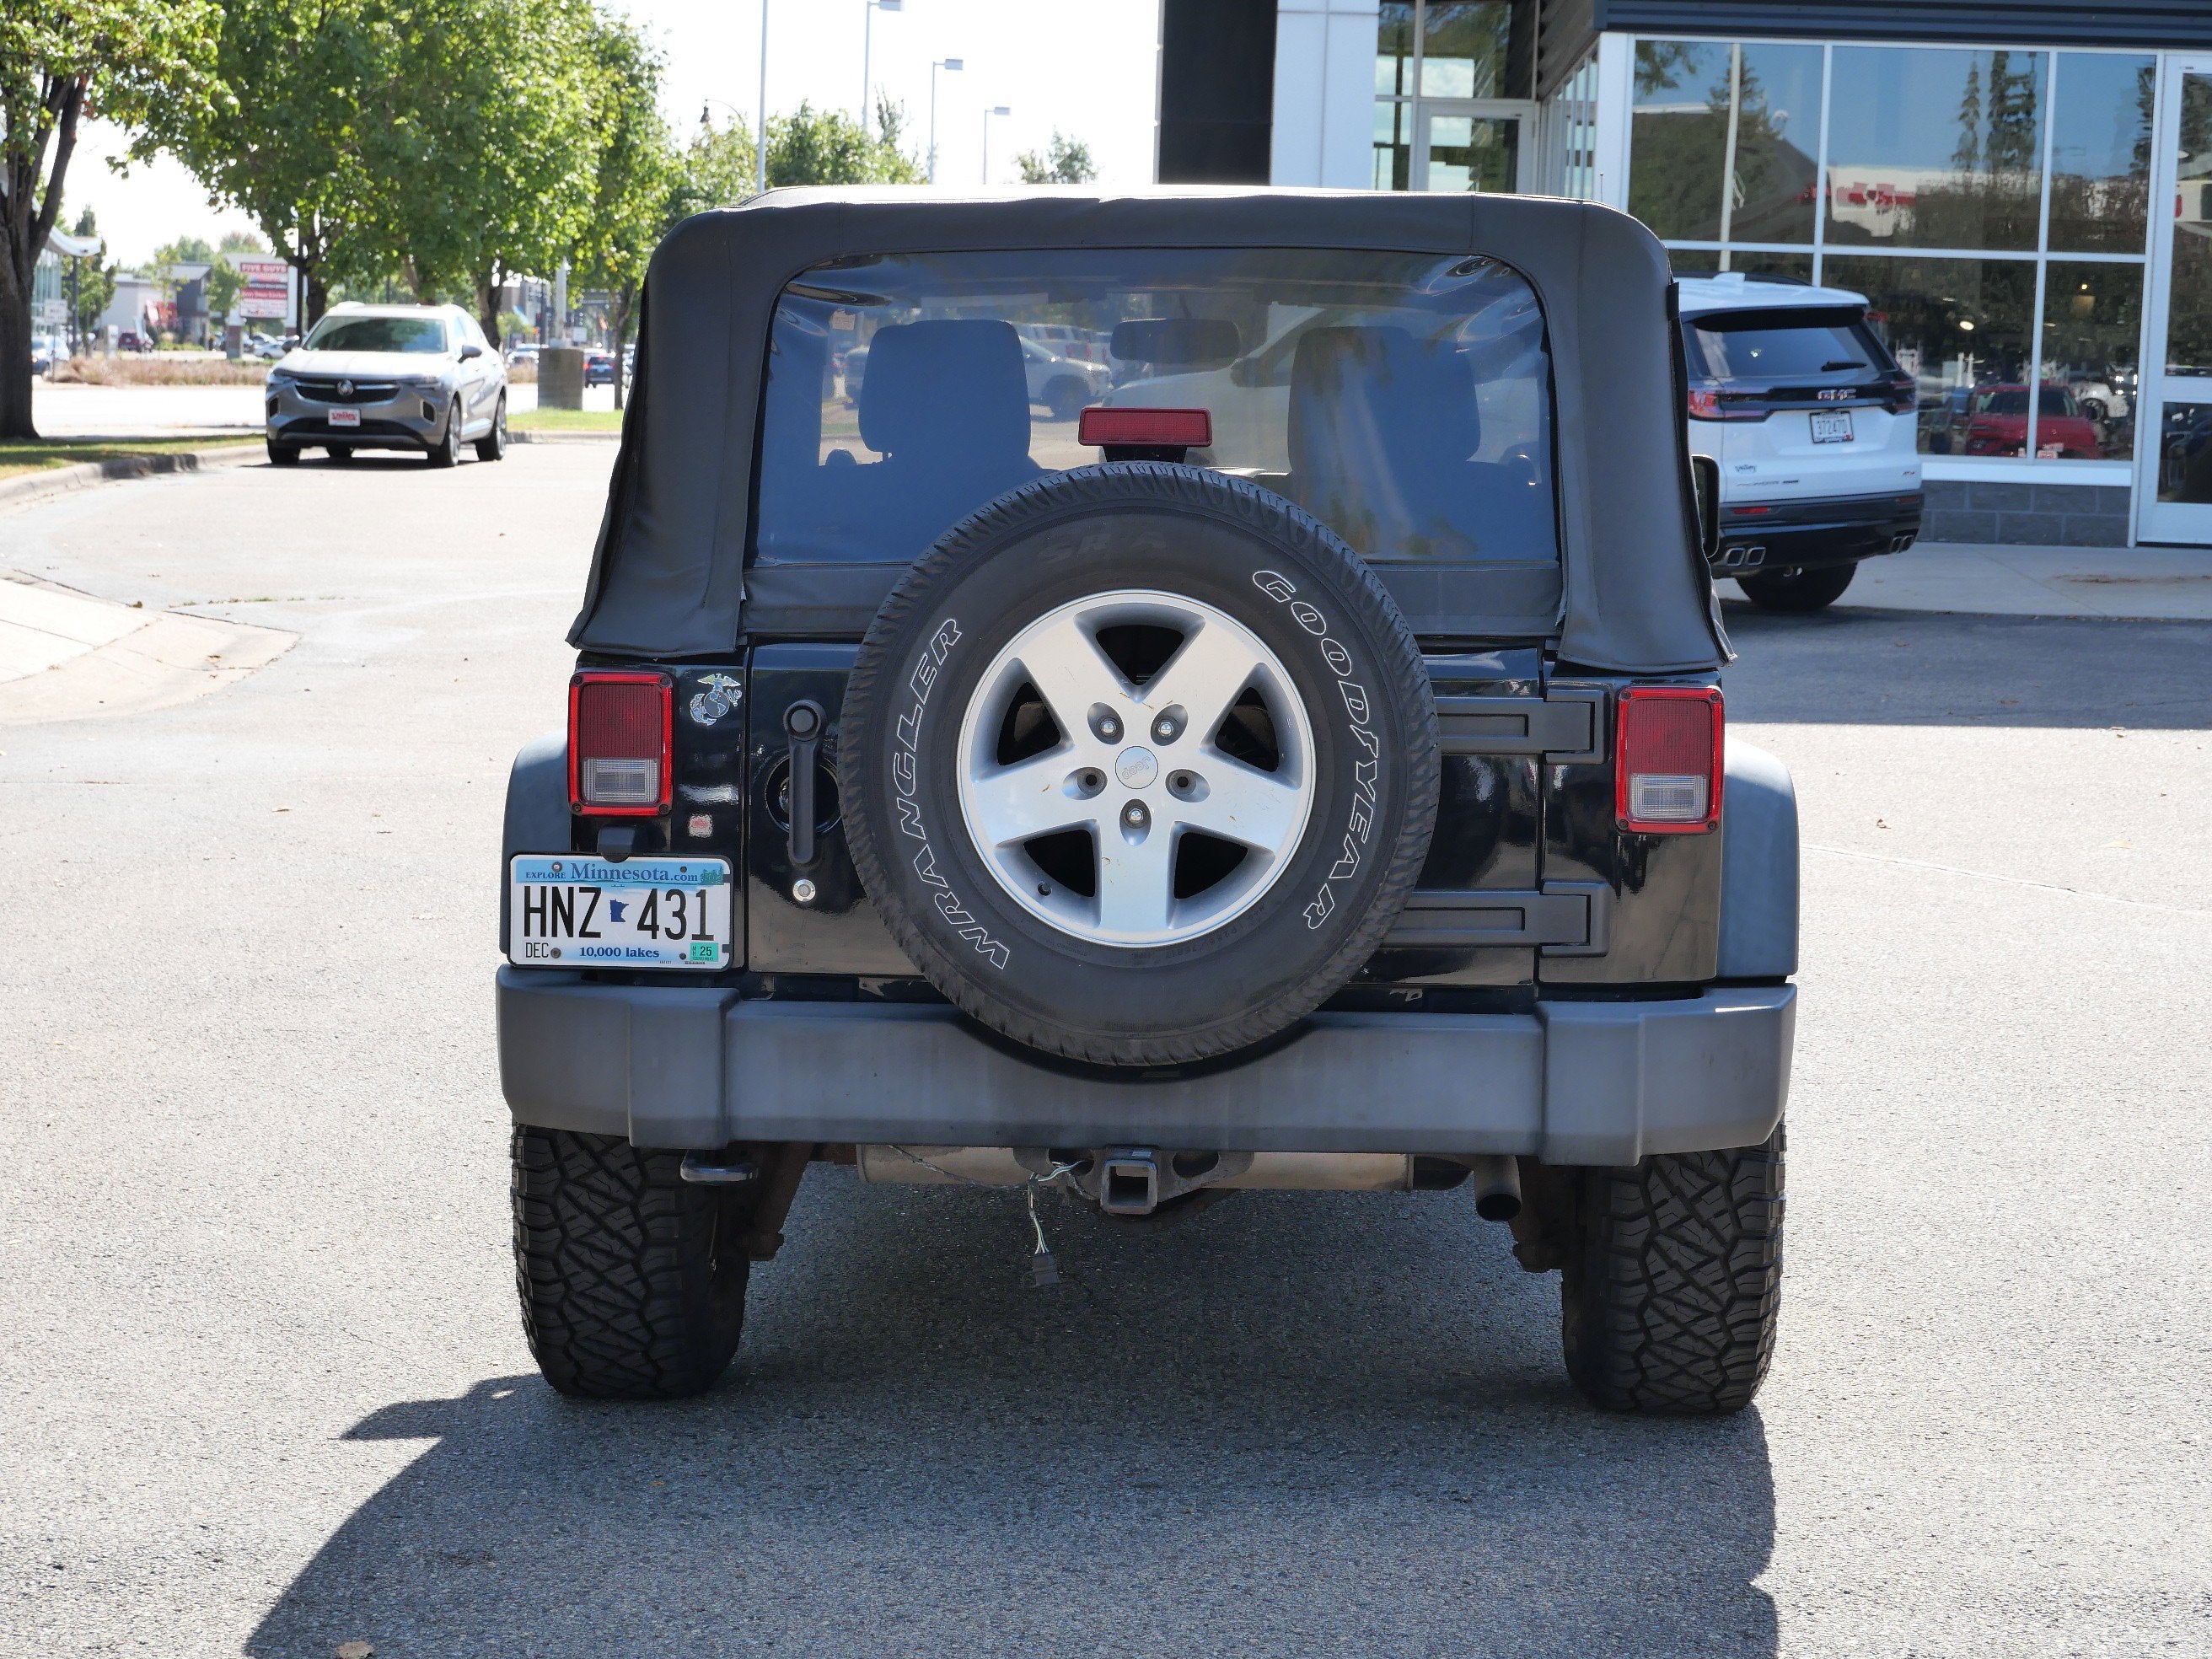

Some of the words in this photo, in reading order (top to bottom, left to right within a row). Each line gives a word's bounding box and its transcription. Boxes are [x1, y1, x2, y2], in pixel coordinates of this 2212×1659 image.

[1817, 389, 1856, 400] GMC
[1253, 571, 1378, 929] GOODYEAR
[893, 619, 1010, 969] WRANGLER
[571, 862, 698, 883] Minnesota.com
[523, 885, 602, 938] HNZ
[636, 888, 714, 941] 431
[525, 942, 549, 958] DEC
[579, 947, 622, 958] 10,000
[625, 947, 660, 958] lakes
[700, 946, 712, 957] 25
